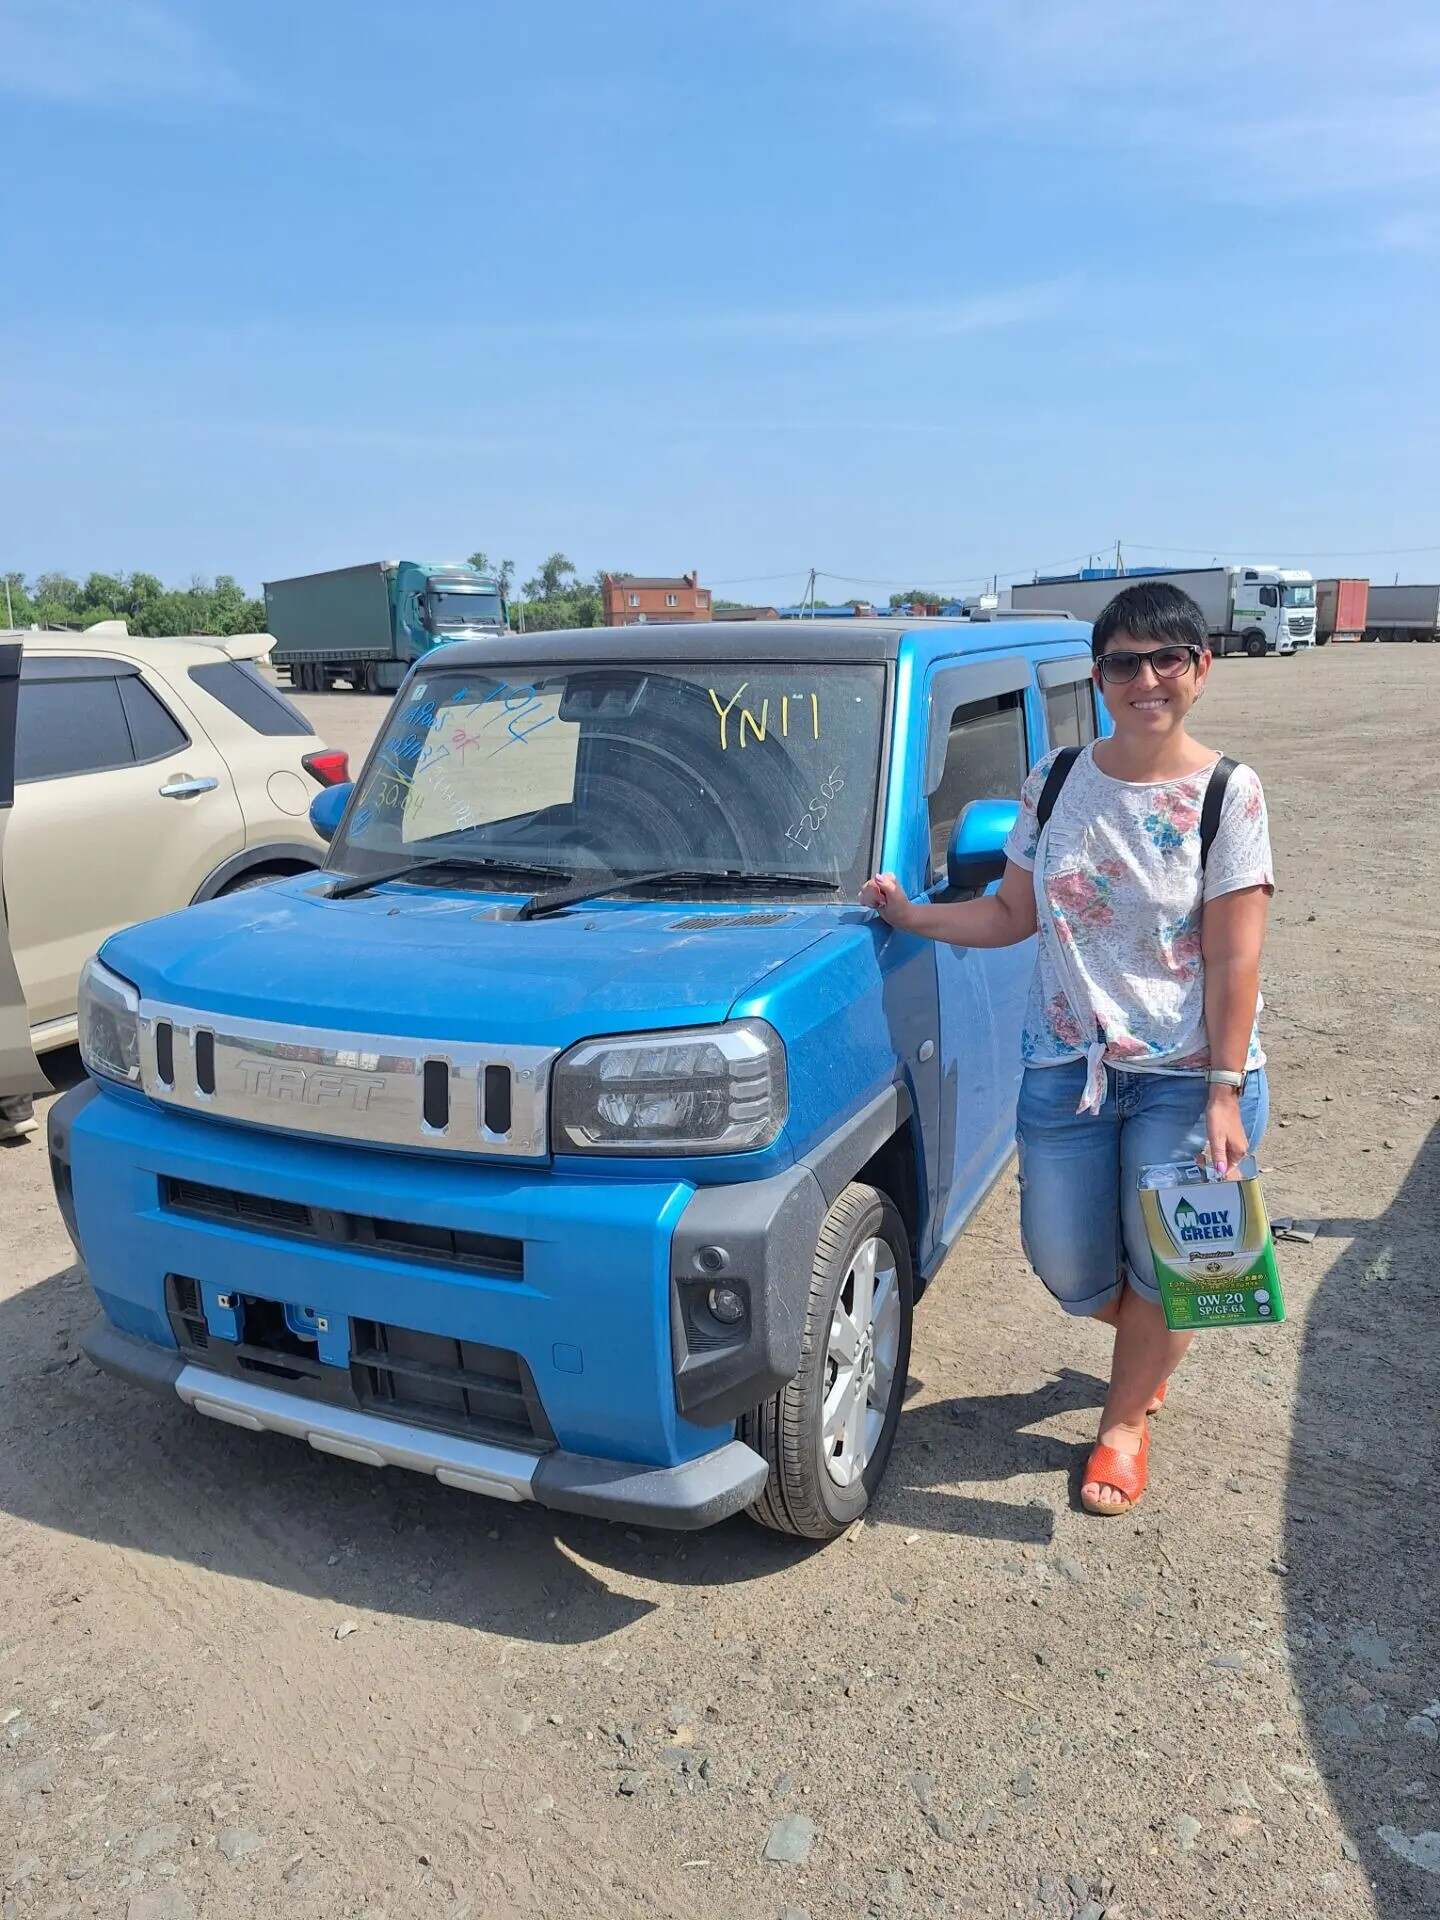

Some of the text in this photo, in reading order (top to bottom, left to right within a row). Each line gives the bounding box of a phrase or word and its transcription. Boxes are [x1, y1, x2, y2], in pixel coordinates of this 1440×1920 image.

[236, 1059, 386, 1112] TAFT
[1176, 1209, 1229, 1228] MOLY
[1181, 1225, 1234, 1241] GREEN
